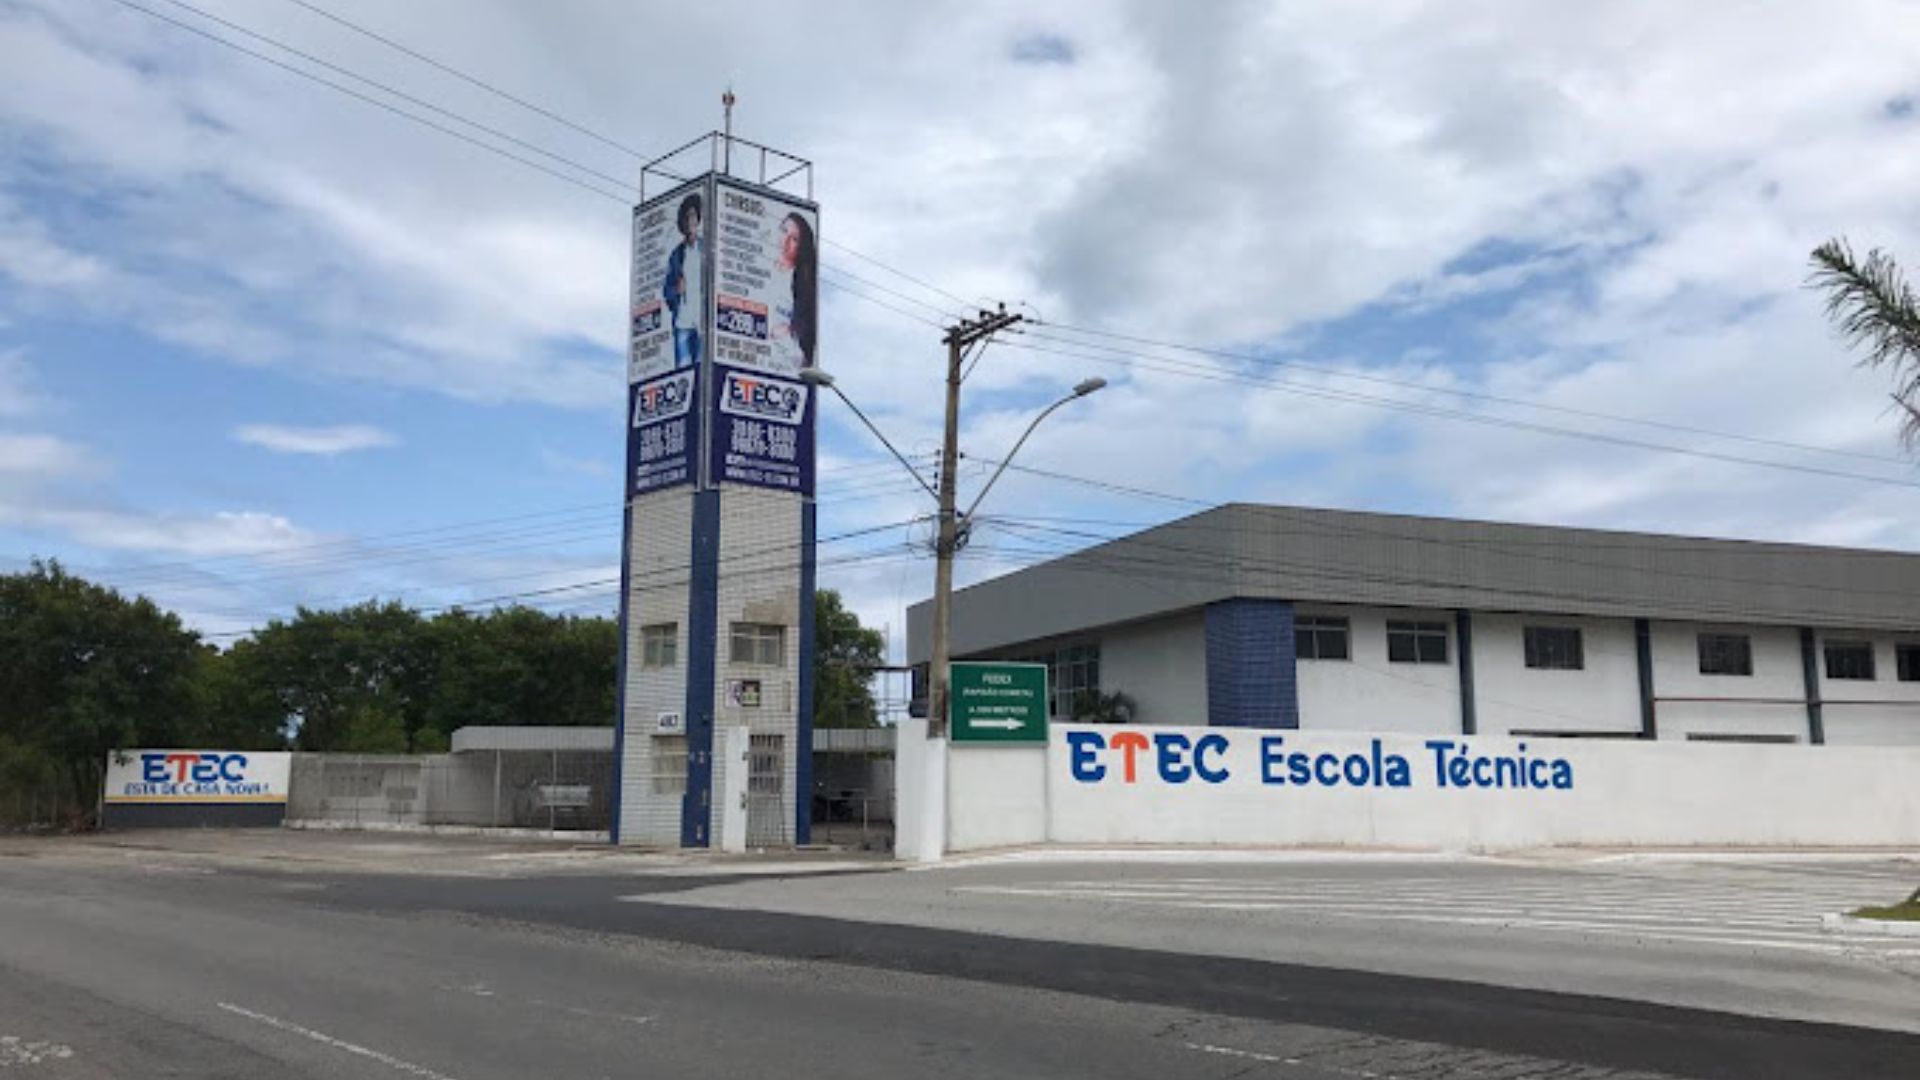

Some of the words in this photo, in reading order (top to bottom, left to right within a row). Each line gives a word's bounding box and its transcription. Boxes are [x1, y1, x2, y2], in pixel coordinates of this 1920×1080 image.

[640, 381, 676, 411] ETEC
[728, 376, 780, 405] ETEC
[141, 754, 247, 782] ETEC
[1066, 731, 1230, 784] ETEC
[1260, 737, 1411, 787] Escola
[1425, 741, 1573, 790] Técnica
[160, 782, 177, 796] DE
[183, 782, 221, 796] CASA
